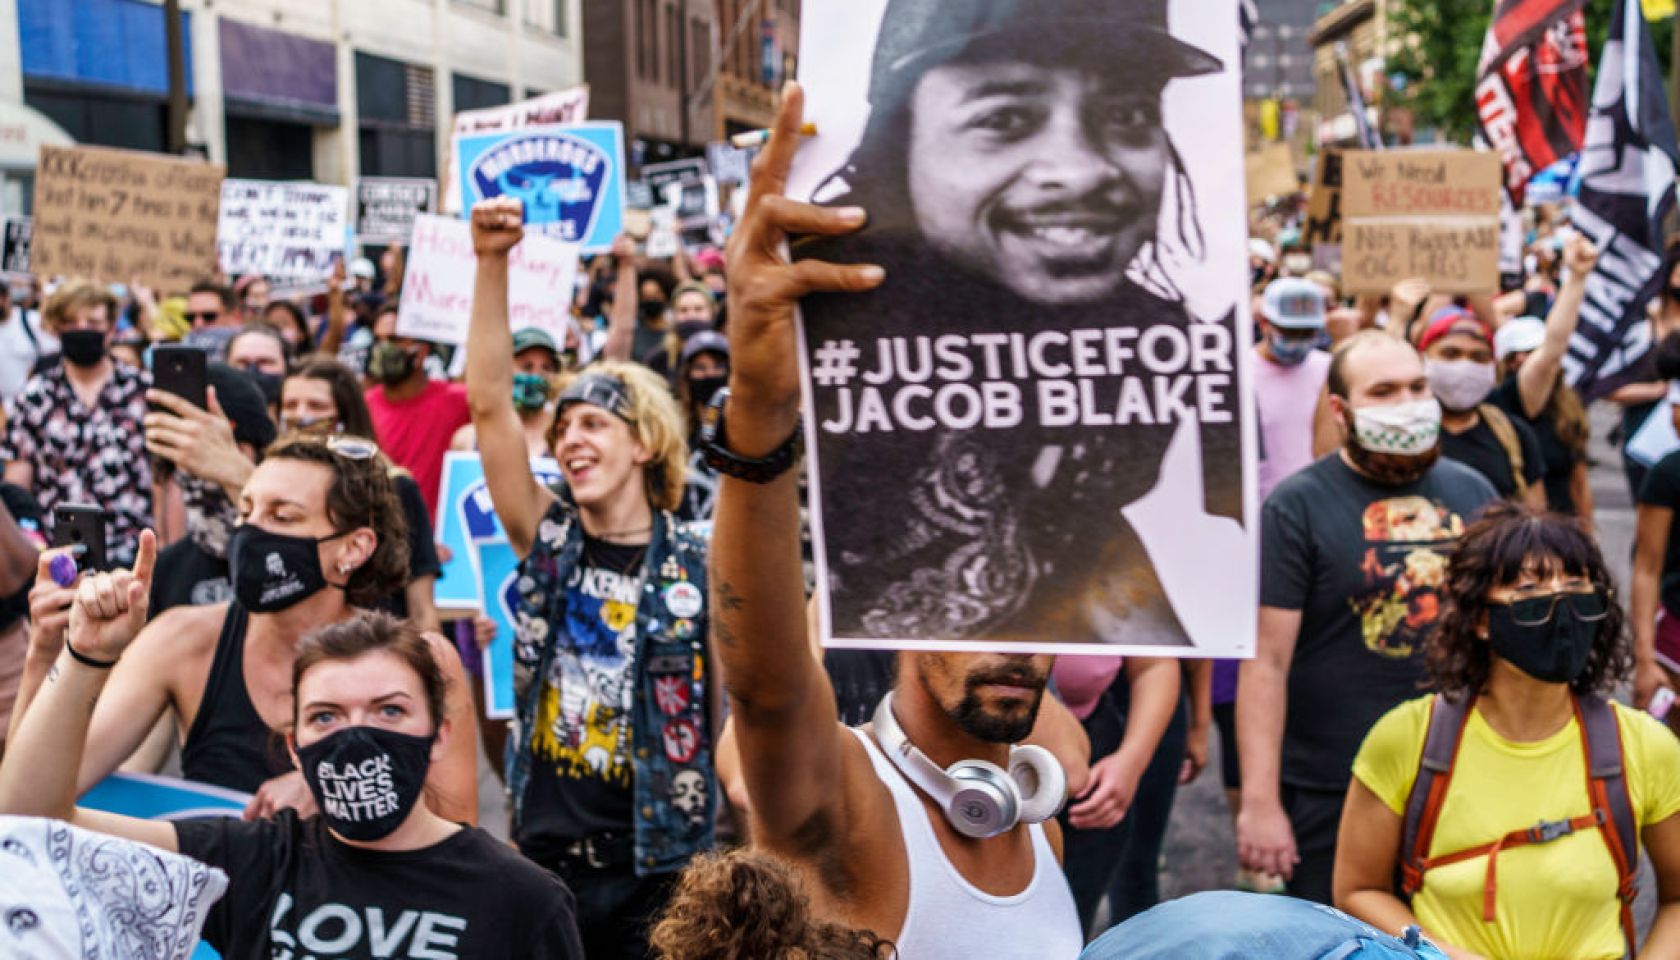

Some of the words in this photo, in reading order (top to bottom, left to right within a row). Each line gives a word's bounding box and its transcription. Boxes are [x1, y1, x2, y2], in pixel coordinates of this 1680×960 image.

[480, 138, 599, 180] MURDEROUS
[1358, 157, 1387, 181] We
[1396, 160, 1447, 184] Need
[109, 189, 130, 217] 7
[1372, 181, 1491, 212] RESOURCES
[522, 219, 578, 239] OLICE
[812, 325, 1233, 386] #JUSTICEFOR
[822, 379, 1022, 433] JACOB
[1037, 373, 1233, 426] BLAKE
[317, 753, 393, 780] BLACK
[319, 772, 395, 801] LIVES
[323, 792, 400, 822] MATTER
[270, 892, 468, 959] LOVE
